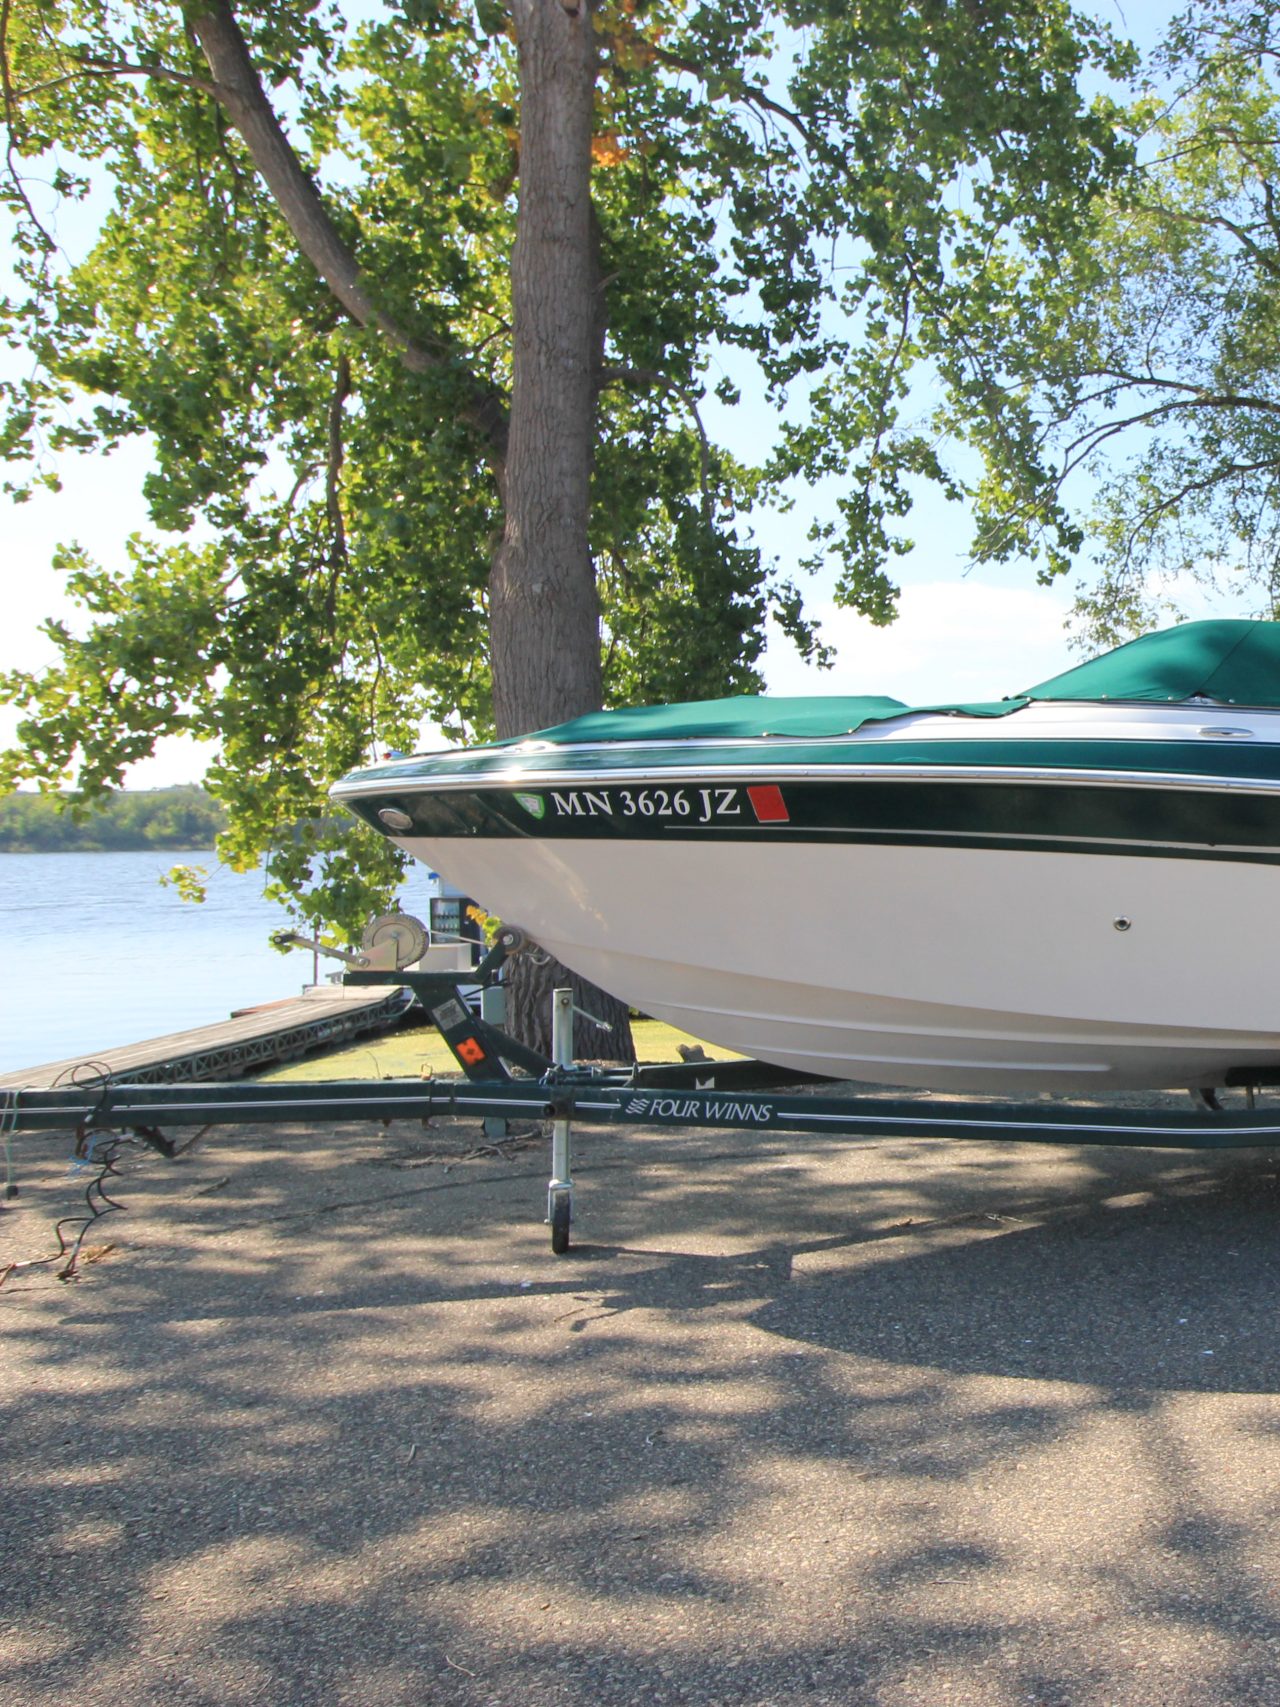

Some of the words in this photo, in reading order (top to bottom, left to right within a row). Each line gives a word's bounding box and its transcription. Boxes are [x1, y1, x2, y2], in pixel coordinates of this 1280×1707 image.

[550, 791, 613, 816] MN
[619, 790, 690, 816] 3626
[699, 788, 741, 822] JZ
[649, 1099, 700, 1118] FOUR
[704, 1101, 773, 1122] WINNS
